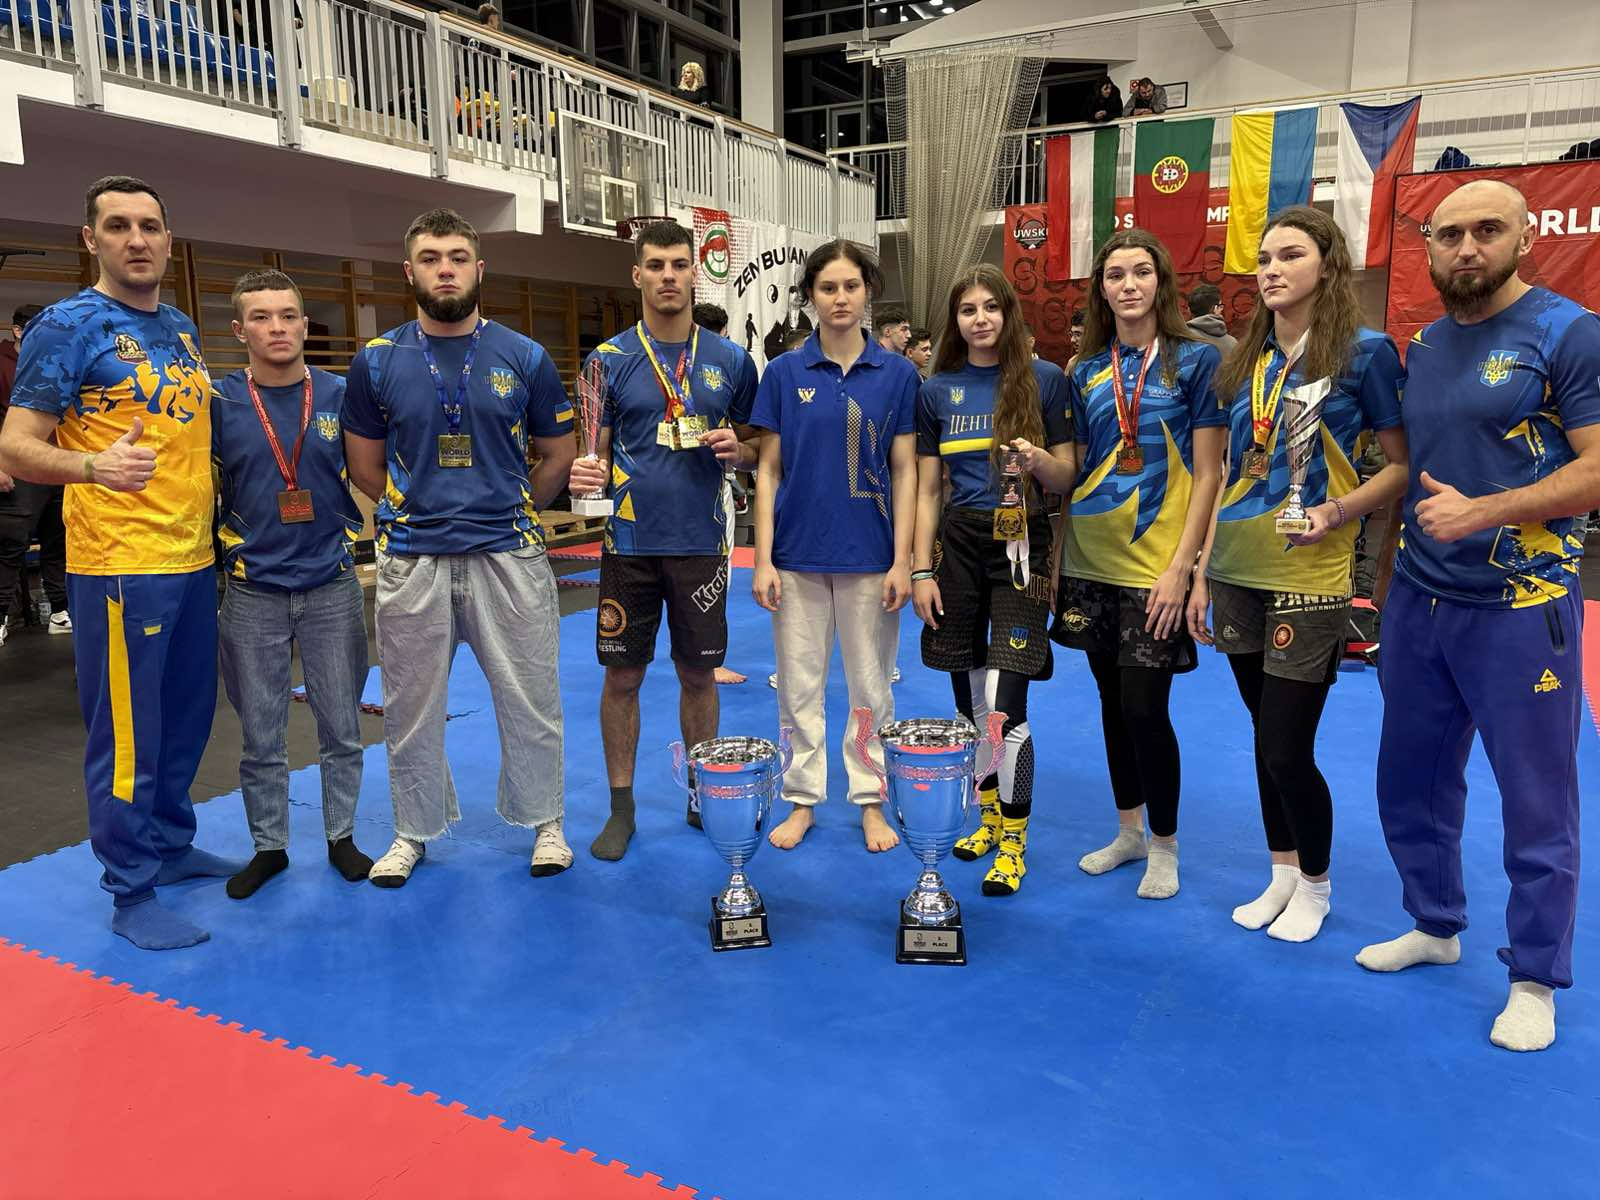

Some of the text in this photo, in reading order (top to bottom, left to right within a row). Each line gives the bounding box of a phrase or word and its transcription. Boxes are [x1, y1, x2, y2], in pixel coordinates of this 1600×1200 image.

[733, 257, 760, 298] ZEN
[949, 414, 994, 435] ЦЕНТ
[1063, 612, 1091, 626] MFC
[1534, 680, 1562, 693] PEAK
